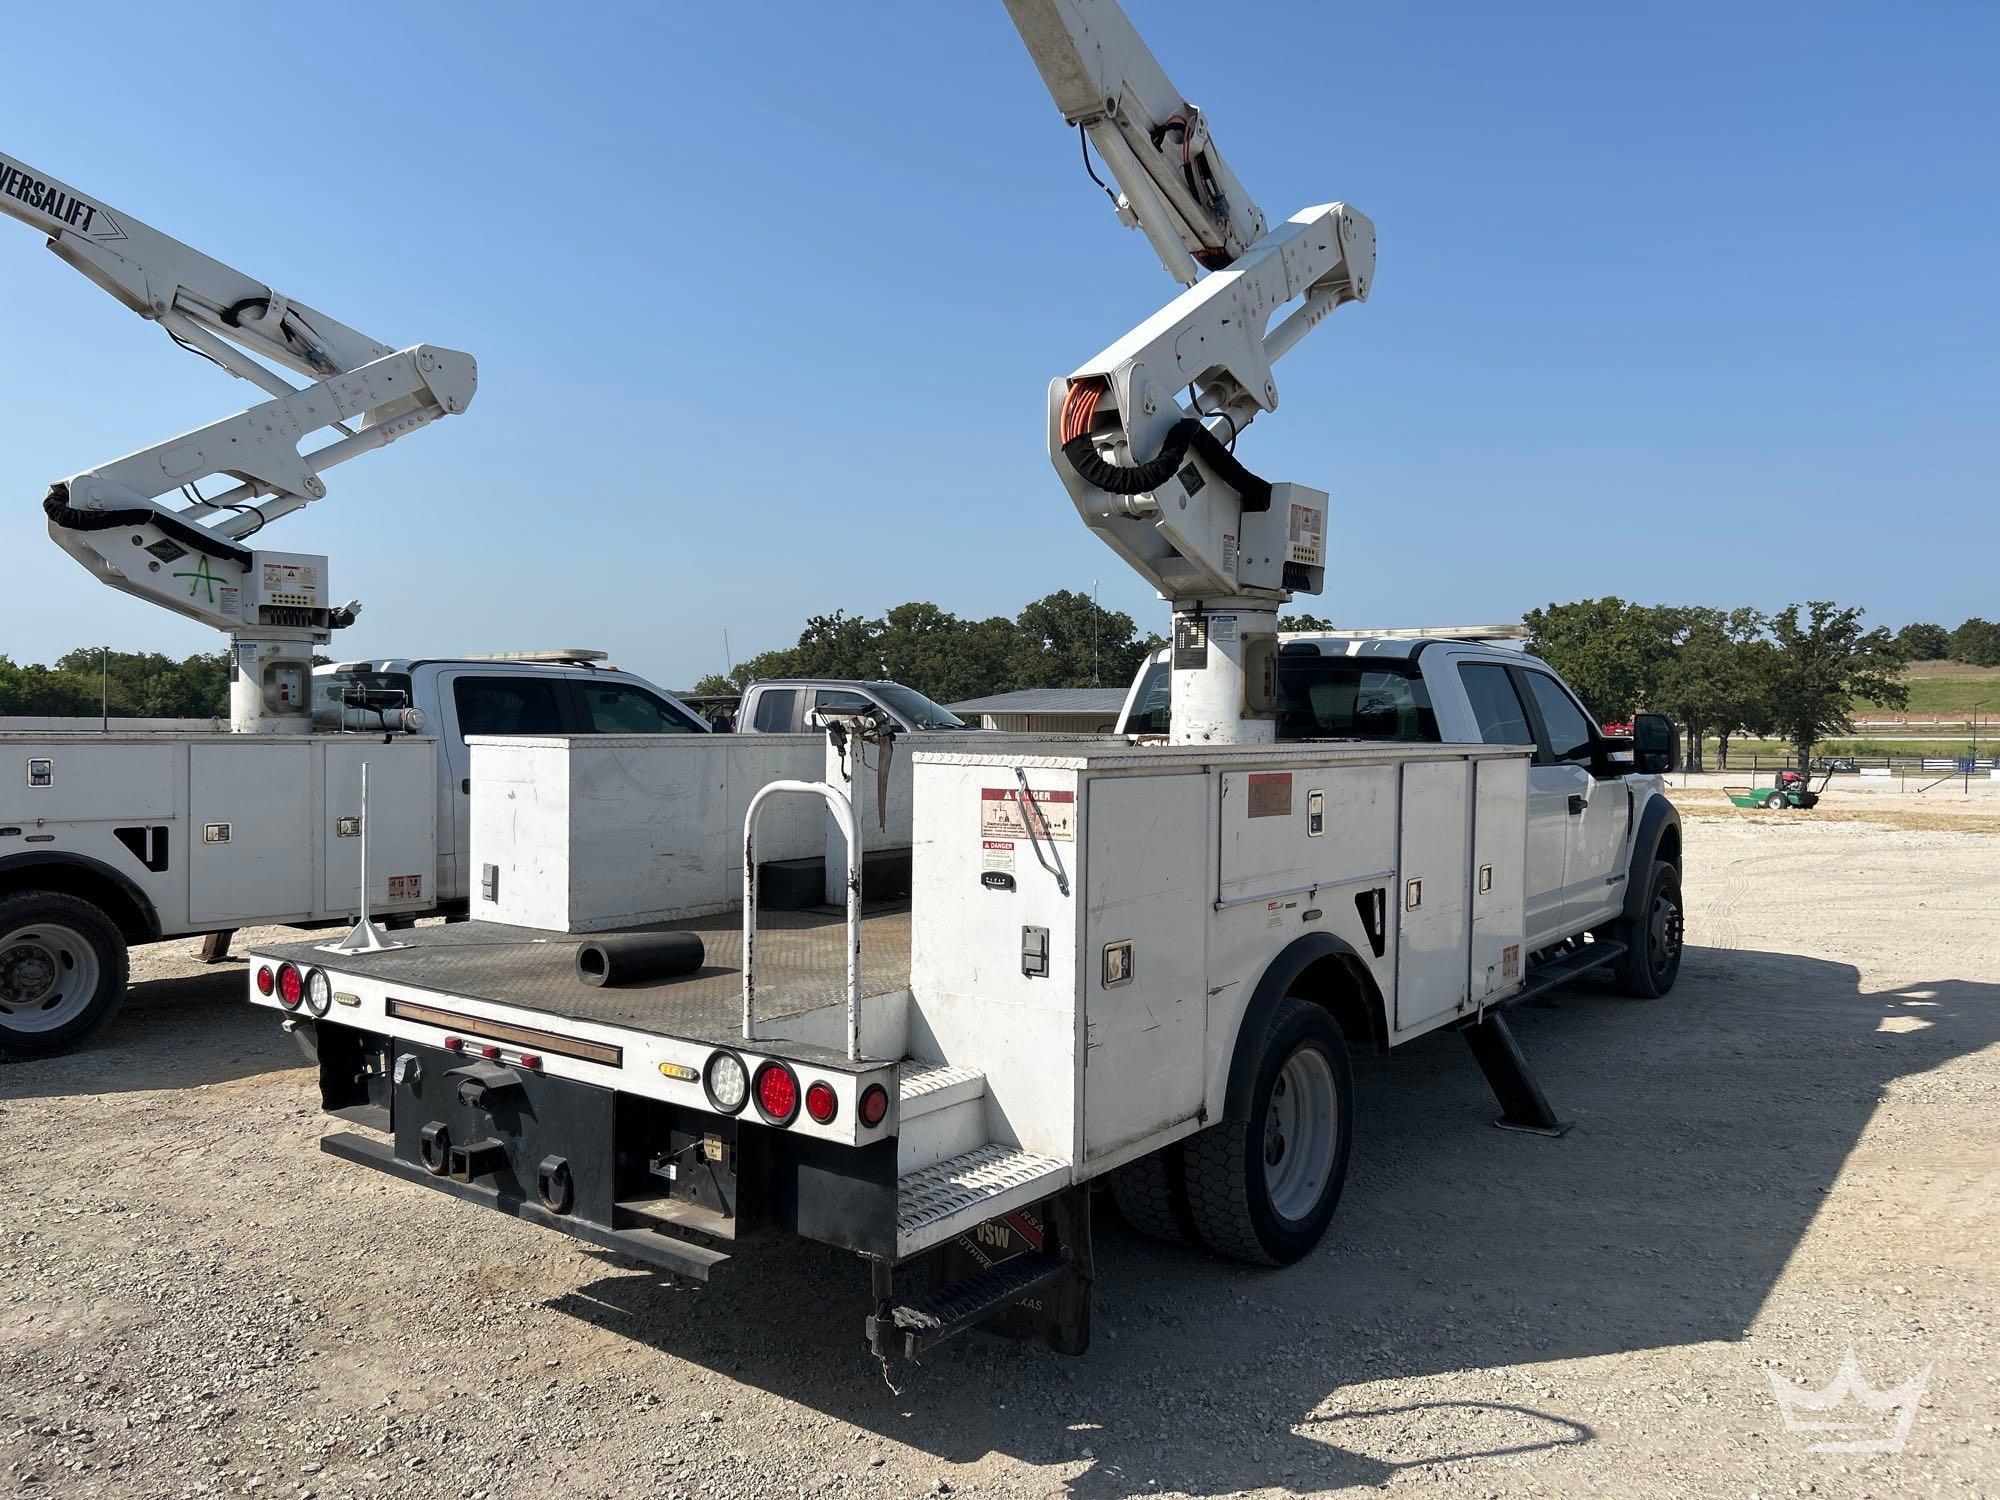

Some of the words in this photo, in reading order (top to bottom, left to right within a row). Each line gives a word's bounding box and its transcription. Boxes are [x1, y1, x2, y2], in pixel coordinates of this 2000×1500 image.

[0, 162, 97, 232] VERSALIFT
[172, 554, 228, 603] A
[990, 842, 1013, 850] DANGER
[976, 1222, 1010, 1249] VSW
[1016, 1298, 1042, 1312] XAS
